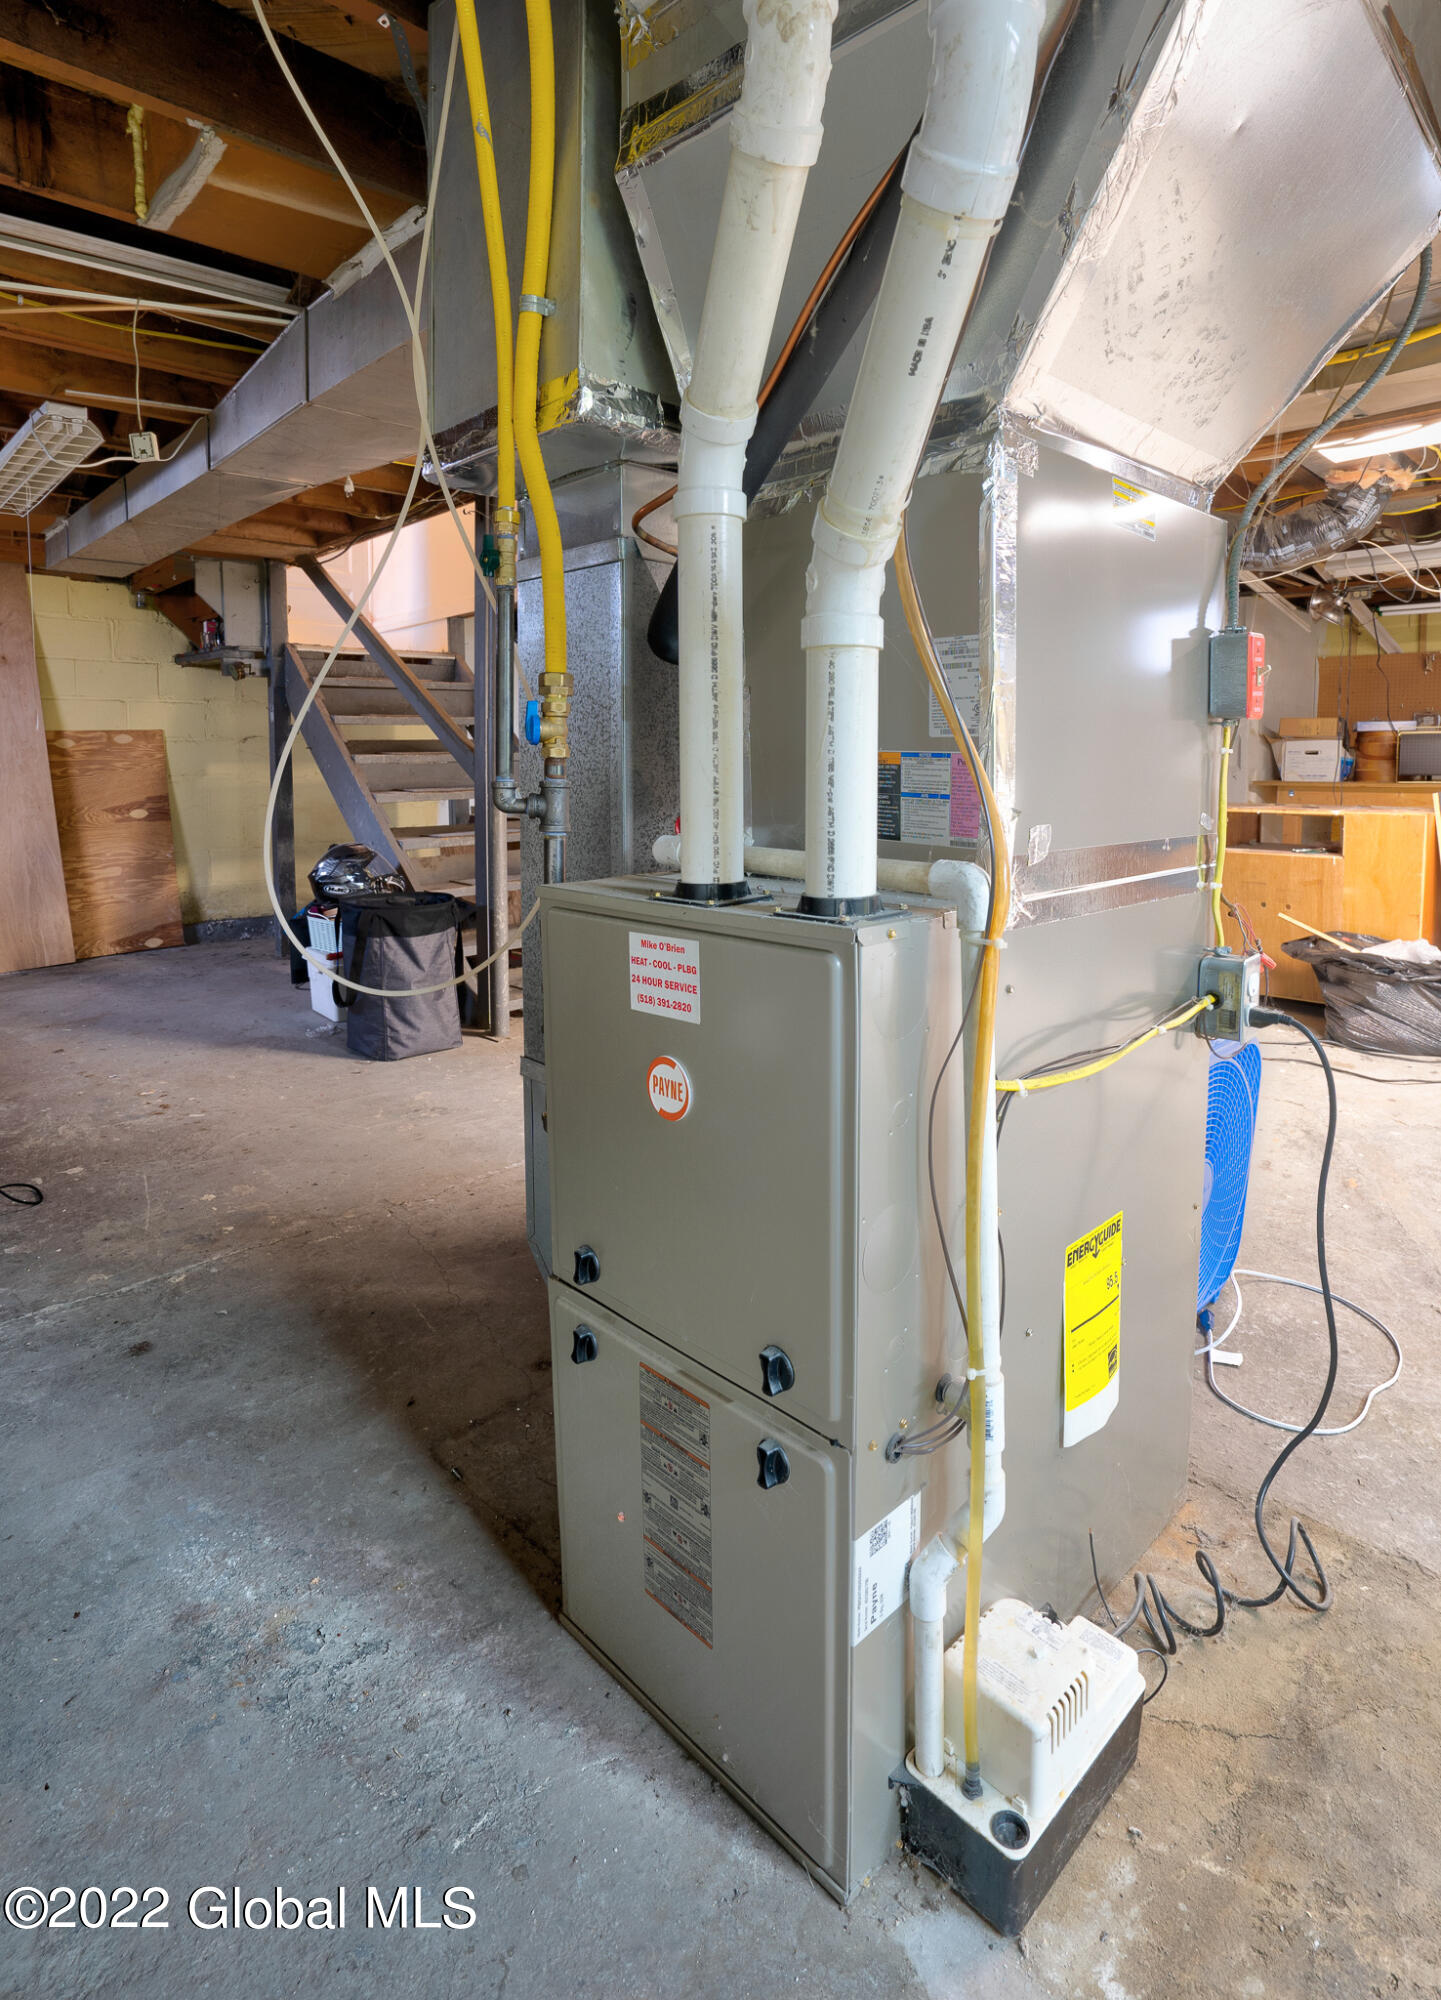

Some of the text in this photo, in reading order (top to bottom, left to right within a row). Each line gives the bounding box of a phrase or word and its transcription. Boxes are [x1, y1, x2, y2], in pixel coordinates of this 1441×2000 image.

[640, 939, 685, 954] Mike O'Brien
[631, 956, 648, 966] HEAT
[652, 959, 672, 971] COOL
[677, 963, 697, 975] PLBG
[631, 974, 698, 995] 24 HOUR SERVICE
[637, 993, 692, 1013] (518) 391-2820
[653, 1074, 683, 1103] PAYNE
[1067, 1218, 1122, 1268] ENERGYGUIDE
